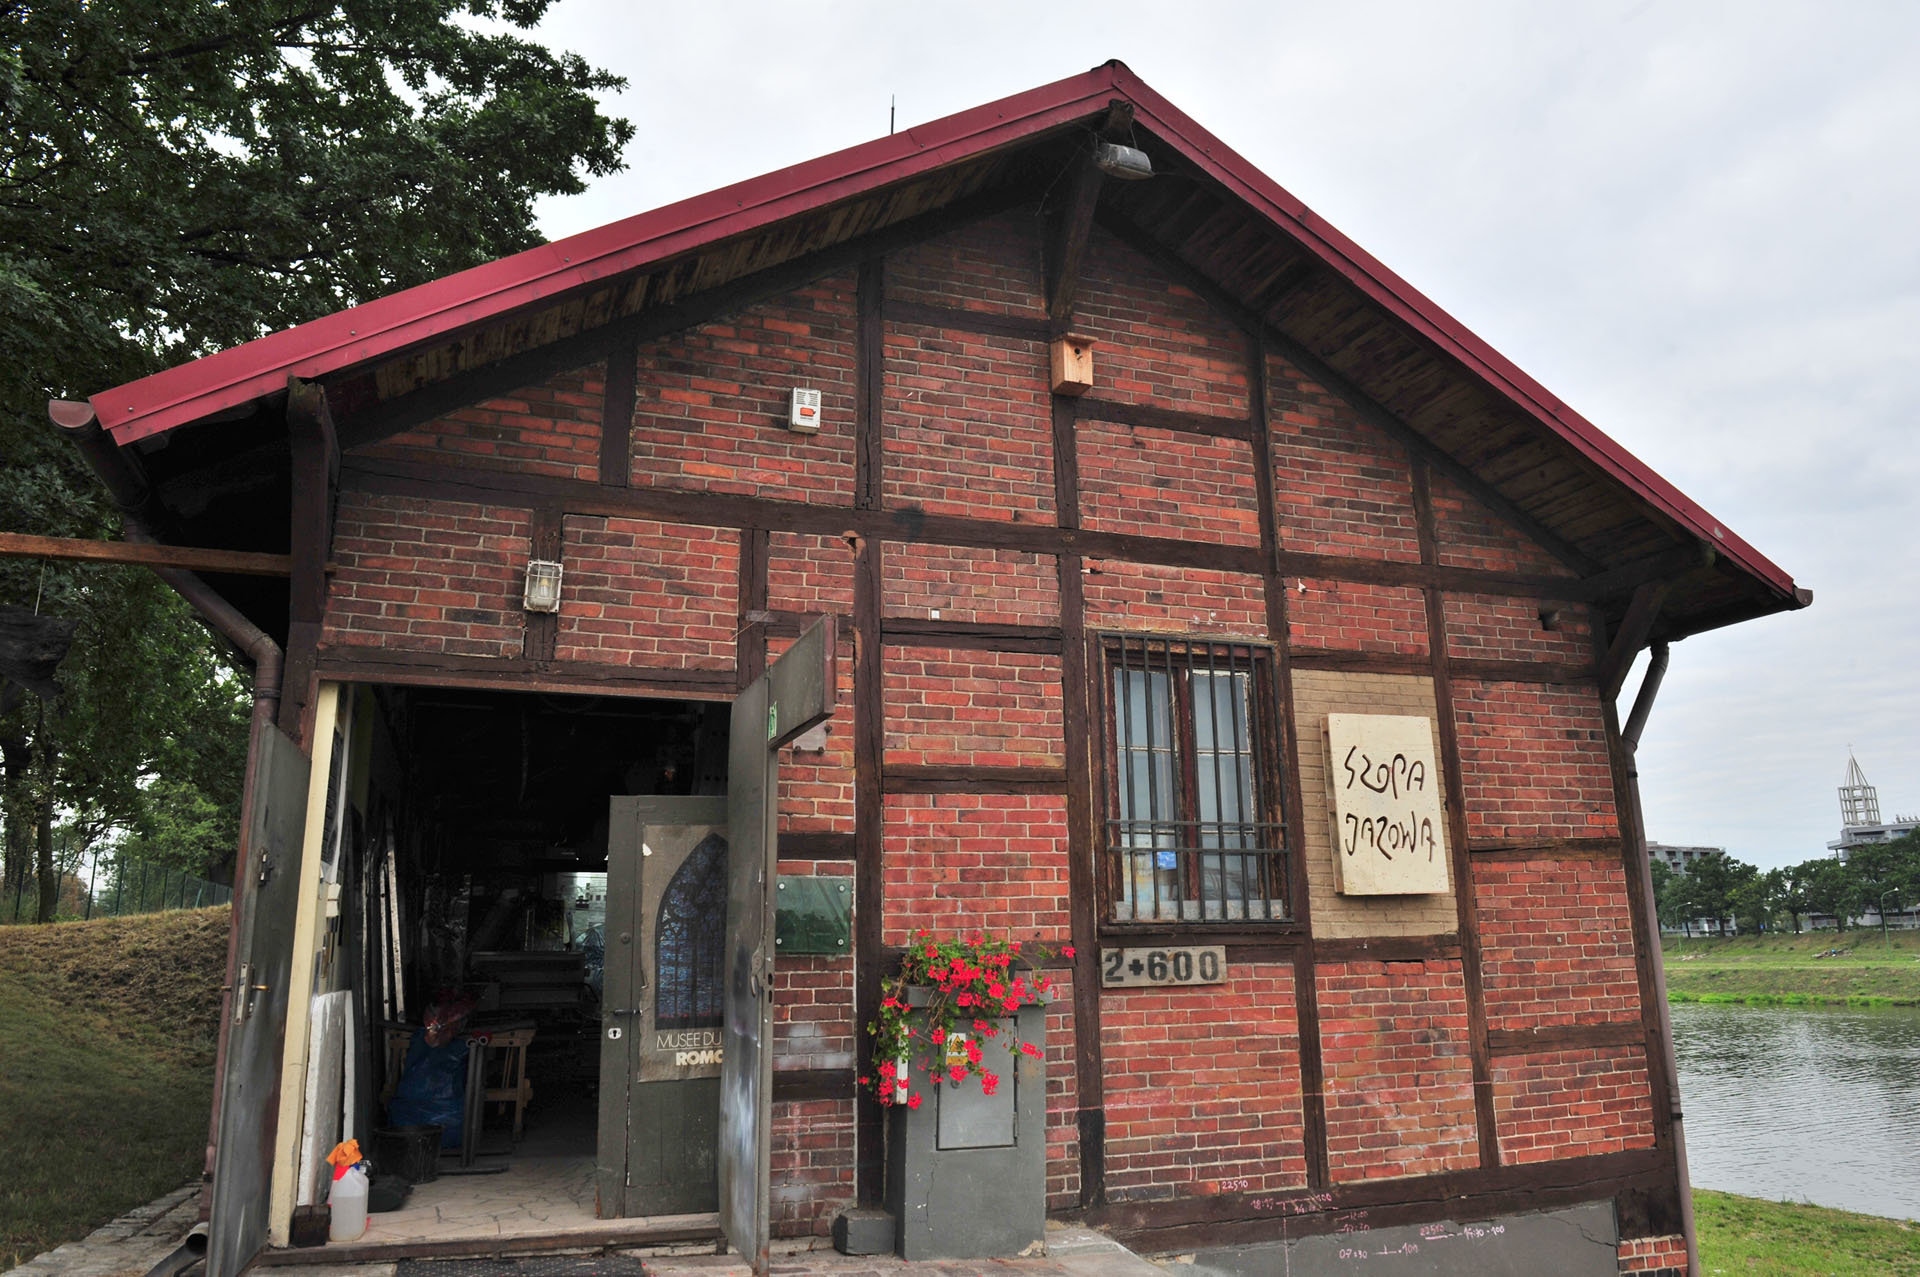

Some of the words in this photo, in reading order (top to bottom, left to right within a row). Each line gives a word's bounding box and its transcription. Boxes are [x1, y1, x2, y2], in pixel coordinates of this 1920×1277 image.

[1344, 745, 1425, 799] SZOPA
[1344, 810, 1437, 862] JAZOWA
[1104, 950, 1219, 982] 2+600
[656, 1032, 701, 1049] MUSEE
[703, 1031, 722, 1046] DU
